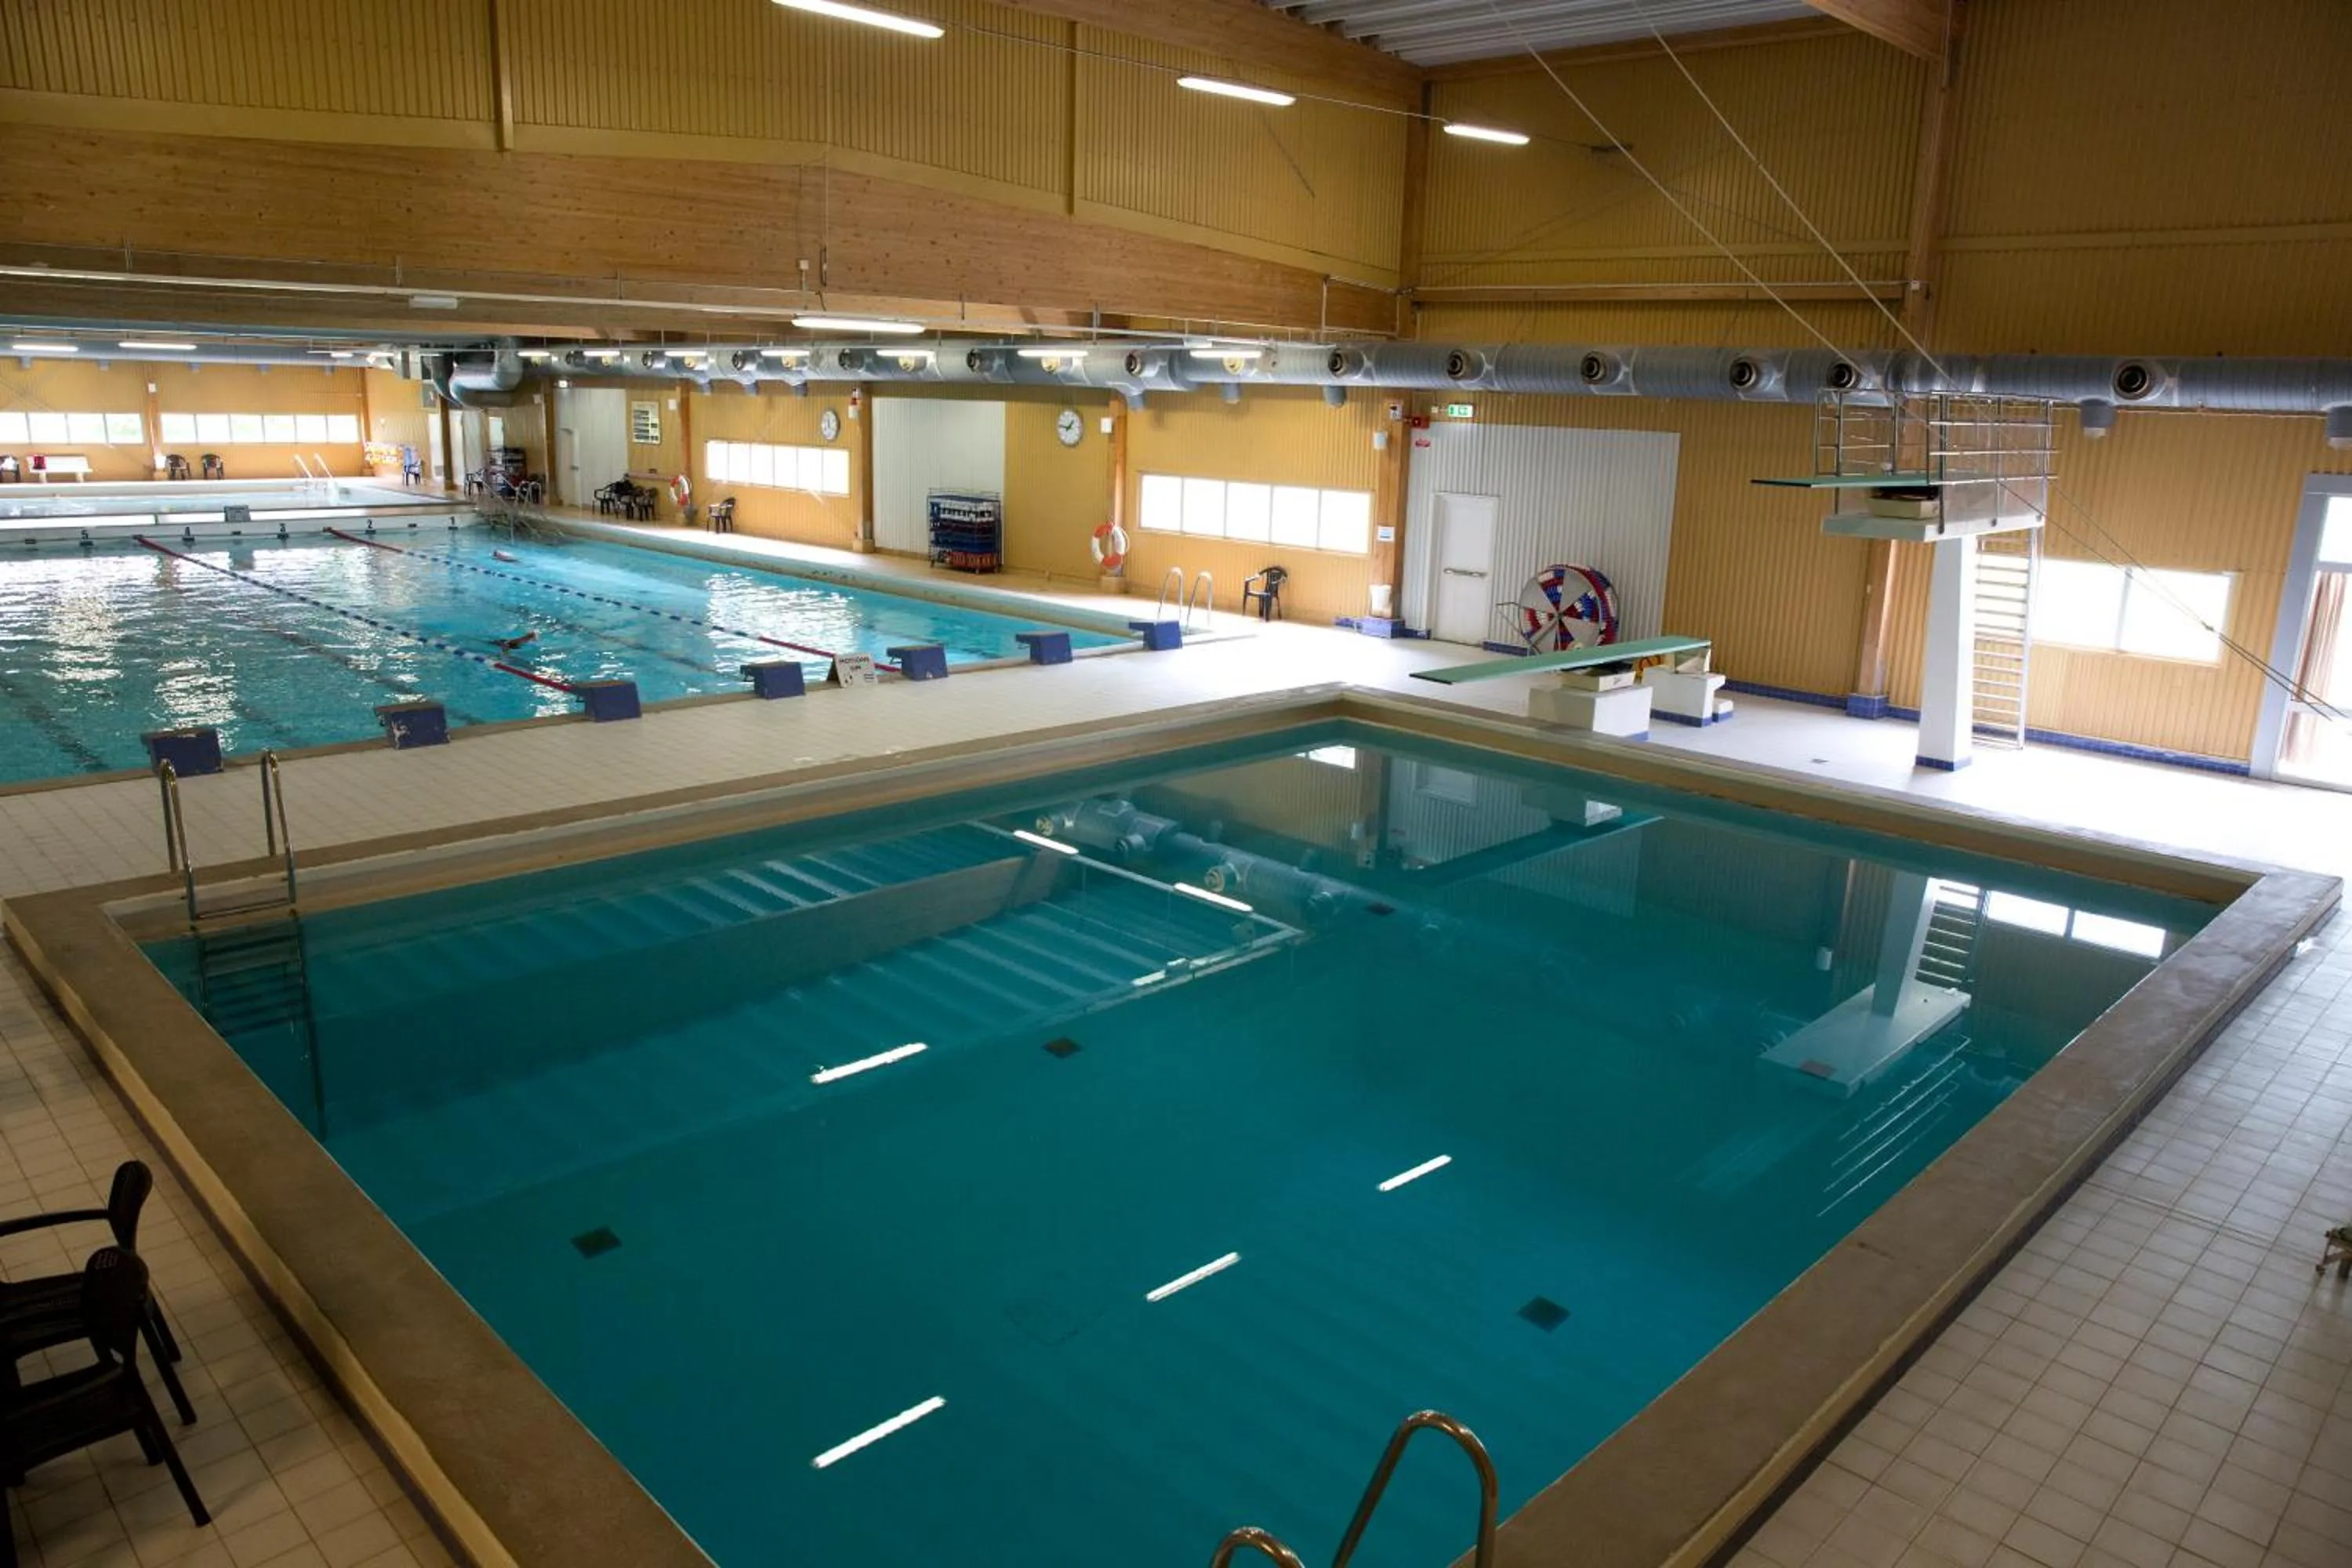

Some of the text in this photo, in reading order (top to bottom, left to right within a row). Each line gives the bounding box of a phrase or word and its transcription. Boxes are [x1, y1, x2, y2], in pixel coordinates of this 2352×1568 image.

[366, 518, 373, 529] 2
[448, 515, 455, 525] 1
[82, 529, 89, 540] 5
